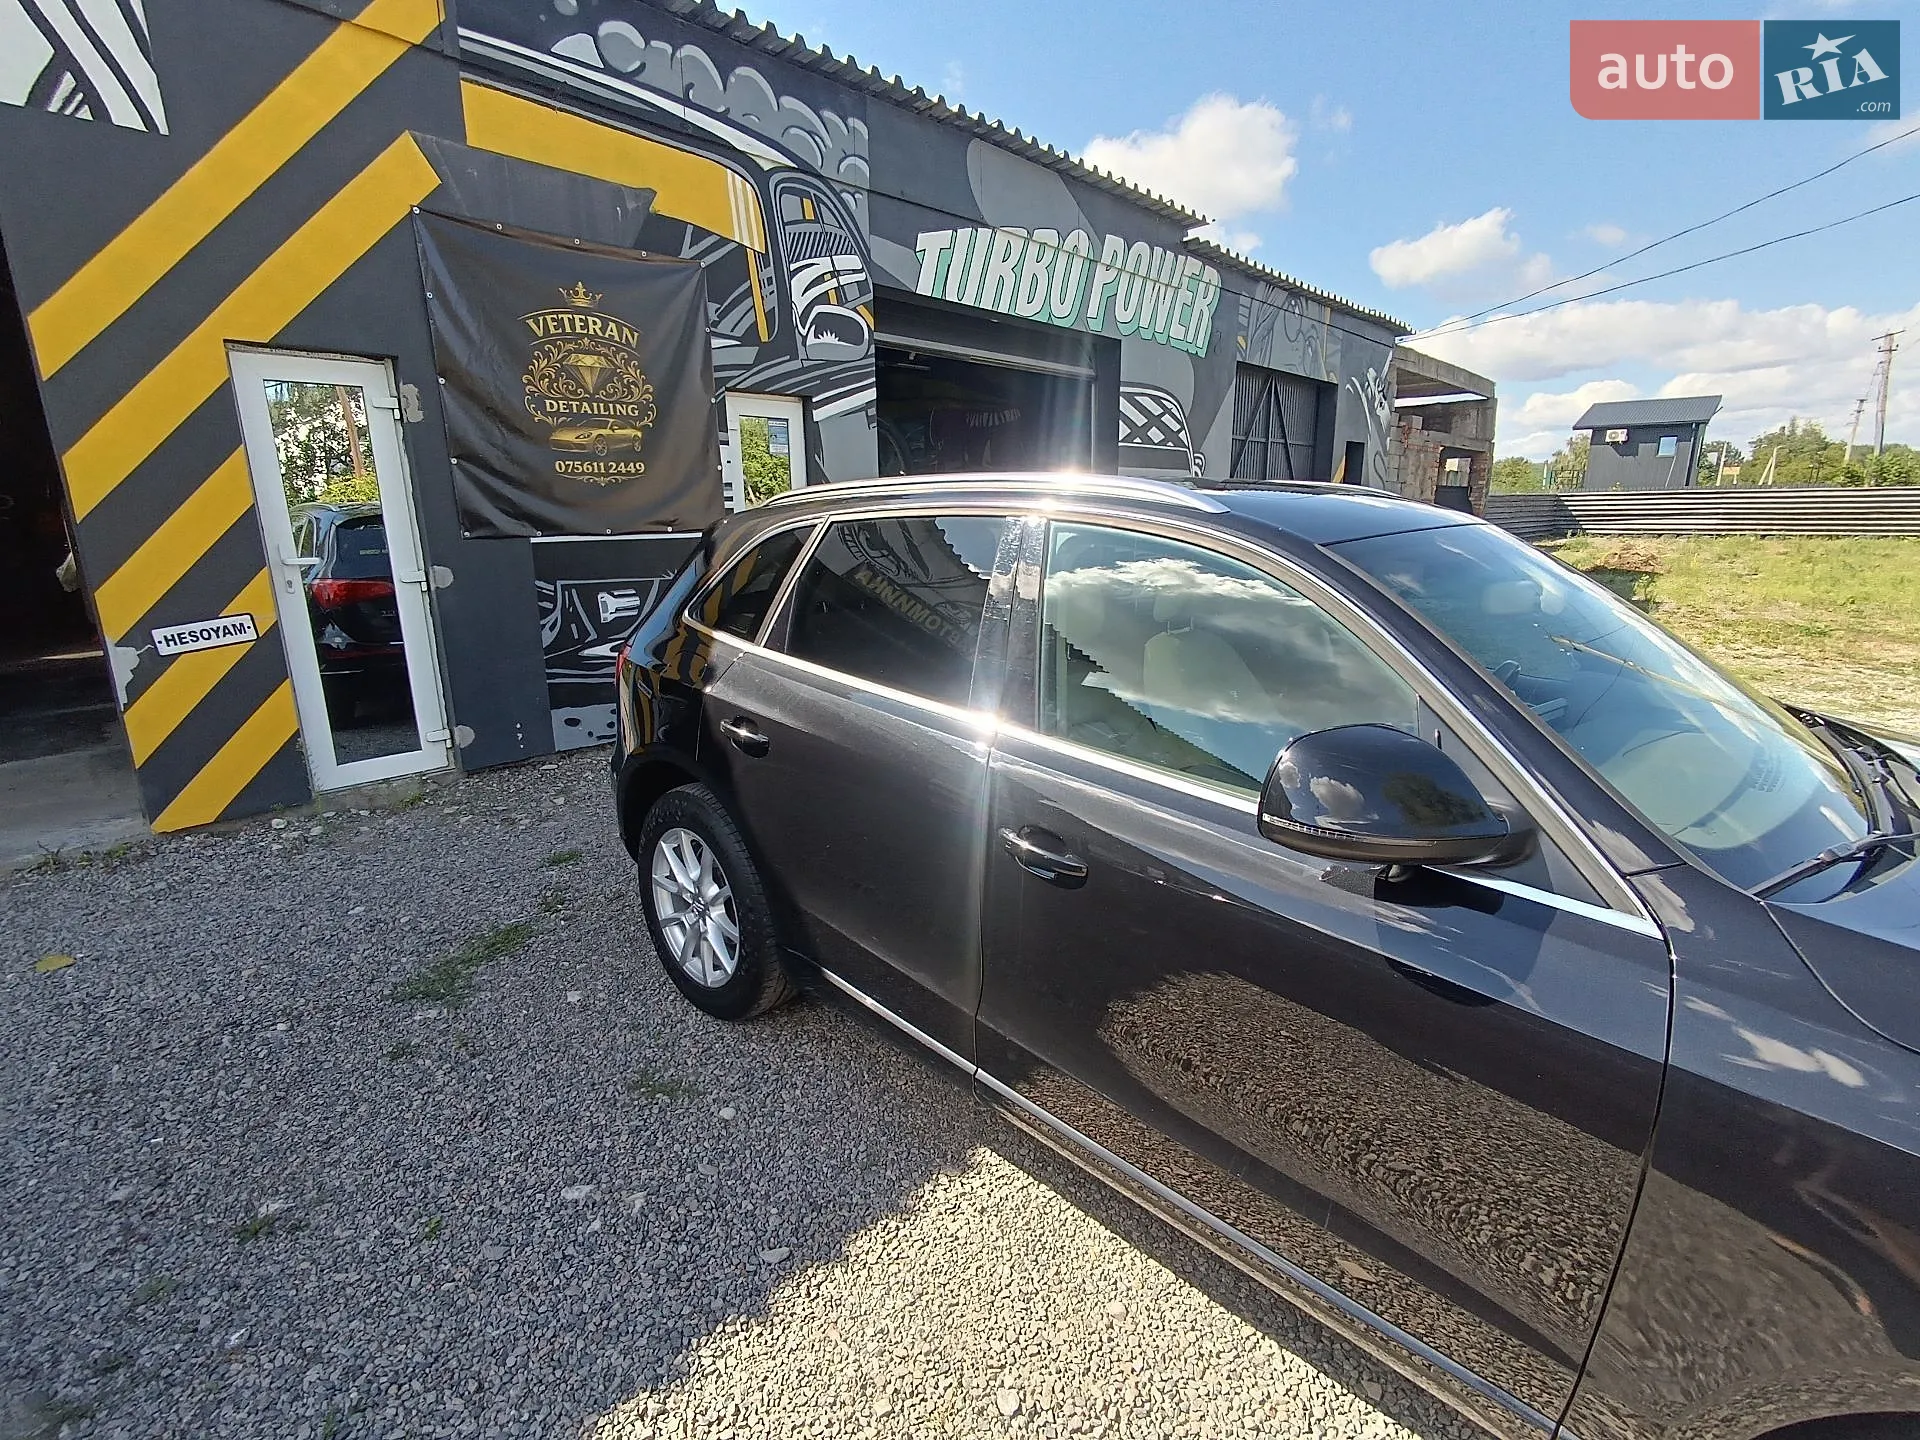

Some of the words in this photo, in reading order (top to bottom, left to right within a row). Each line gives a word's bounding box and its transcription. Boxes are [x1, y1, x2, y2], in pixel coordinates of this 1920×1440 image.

[915, 226, 1094, 328] TURBO
[1085, 234, 1222, 358] POWER
[526, 313, 640, 349] VETERAN
[544, 398, 639, 417] DETAILING
